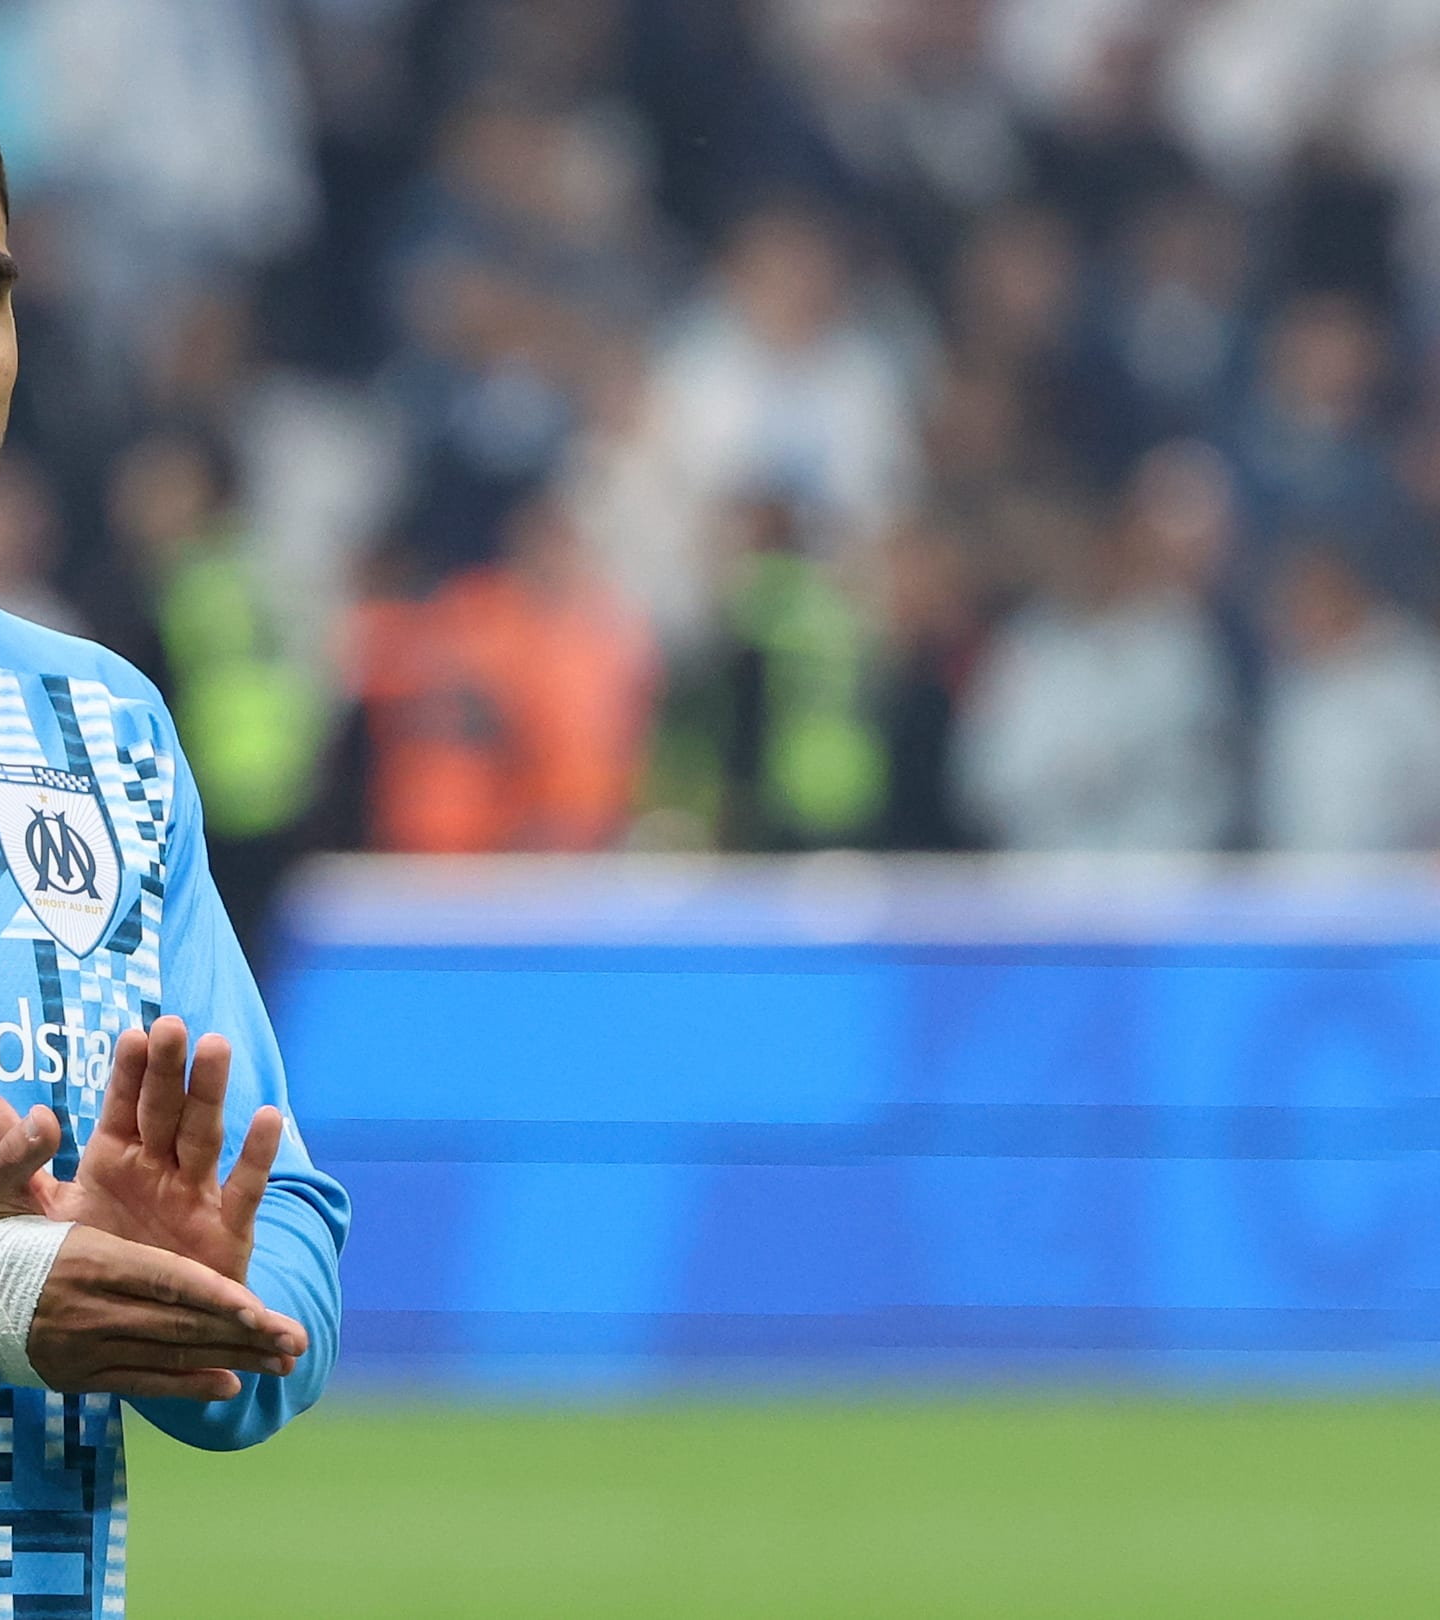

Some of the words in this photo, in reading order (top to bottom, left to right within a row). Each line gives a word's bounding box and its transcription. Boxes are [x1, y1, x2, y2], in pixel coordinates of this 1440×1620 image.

[35, 898, 67, 910] DROIT
[69, 902, 82, 912] AU
[85, 904, 105, 915] BUT
